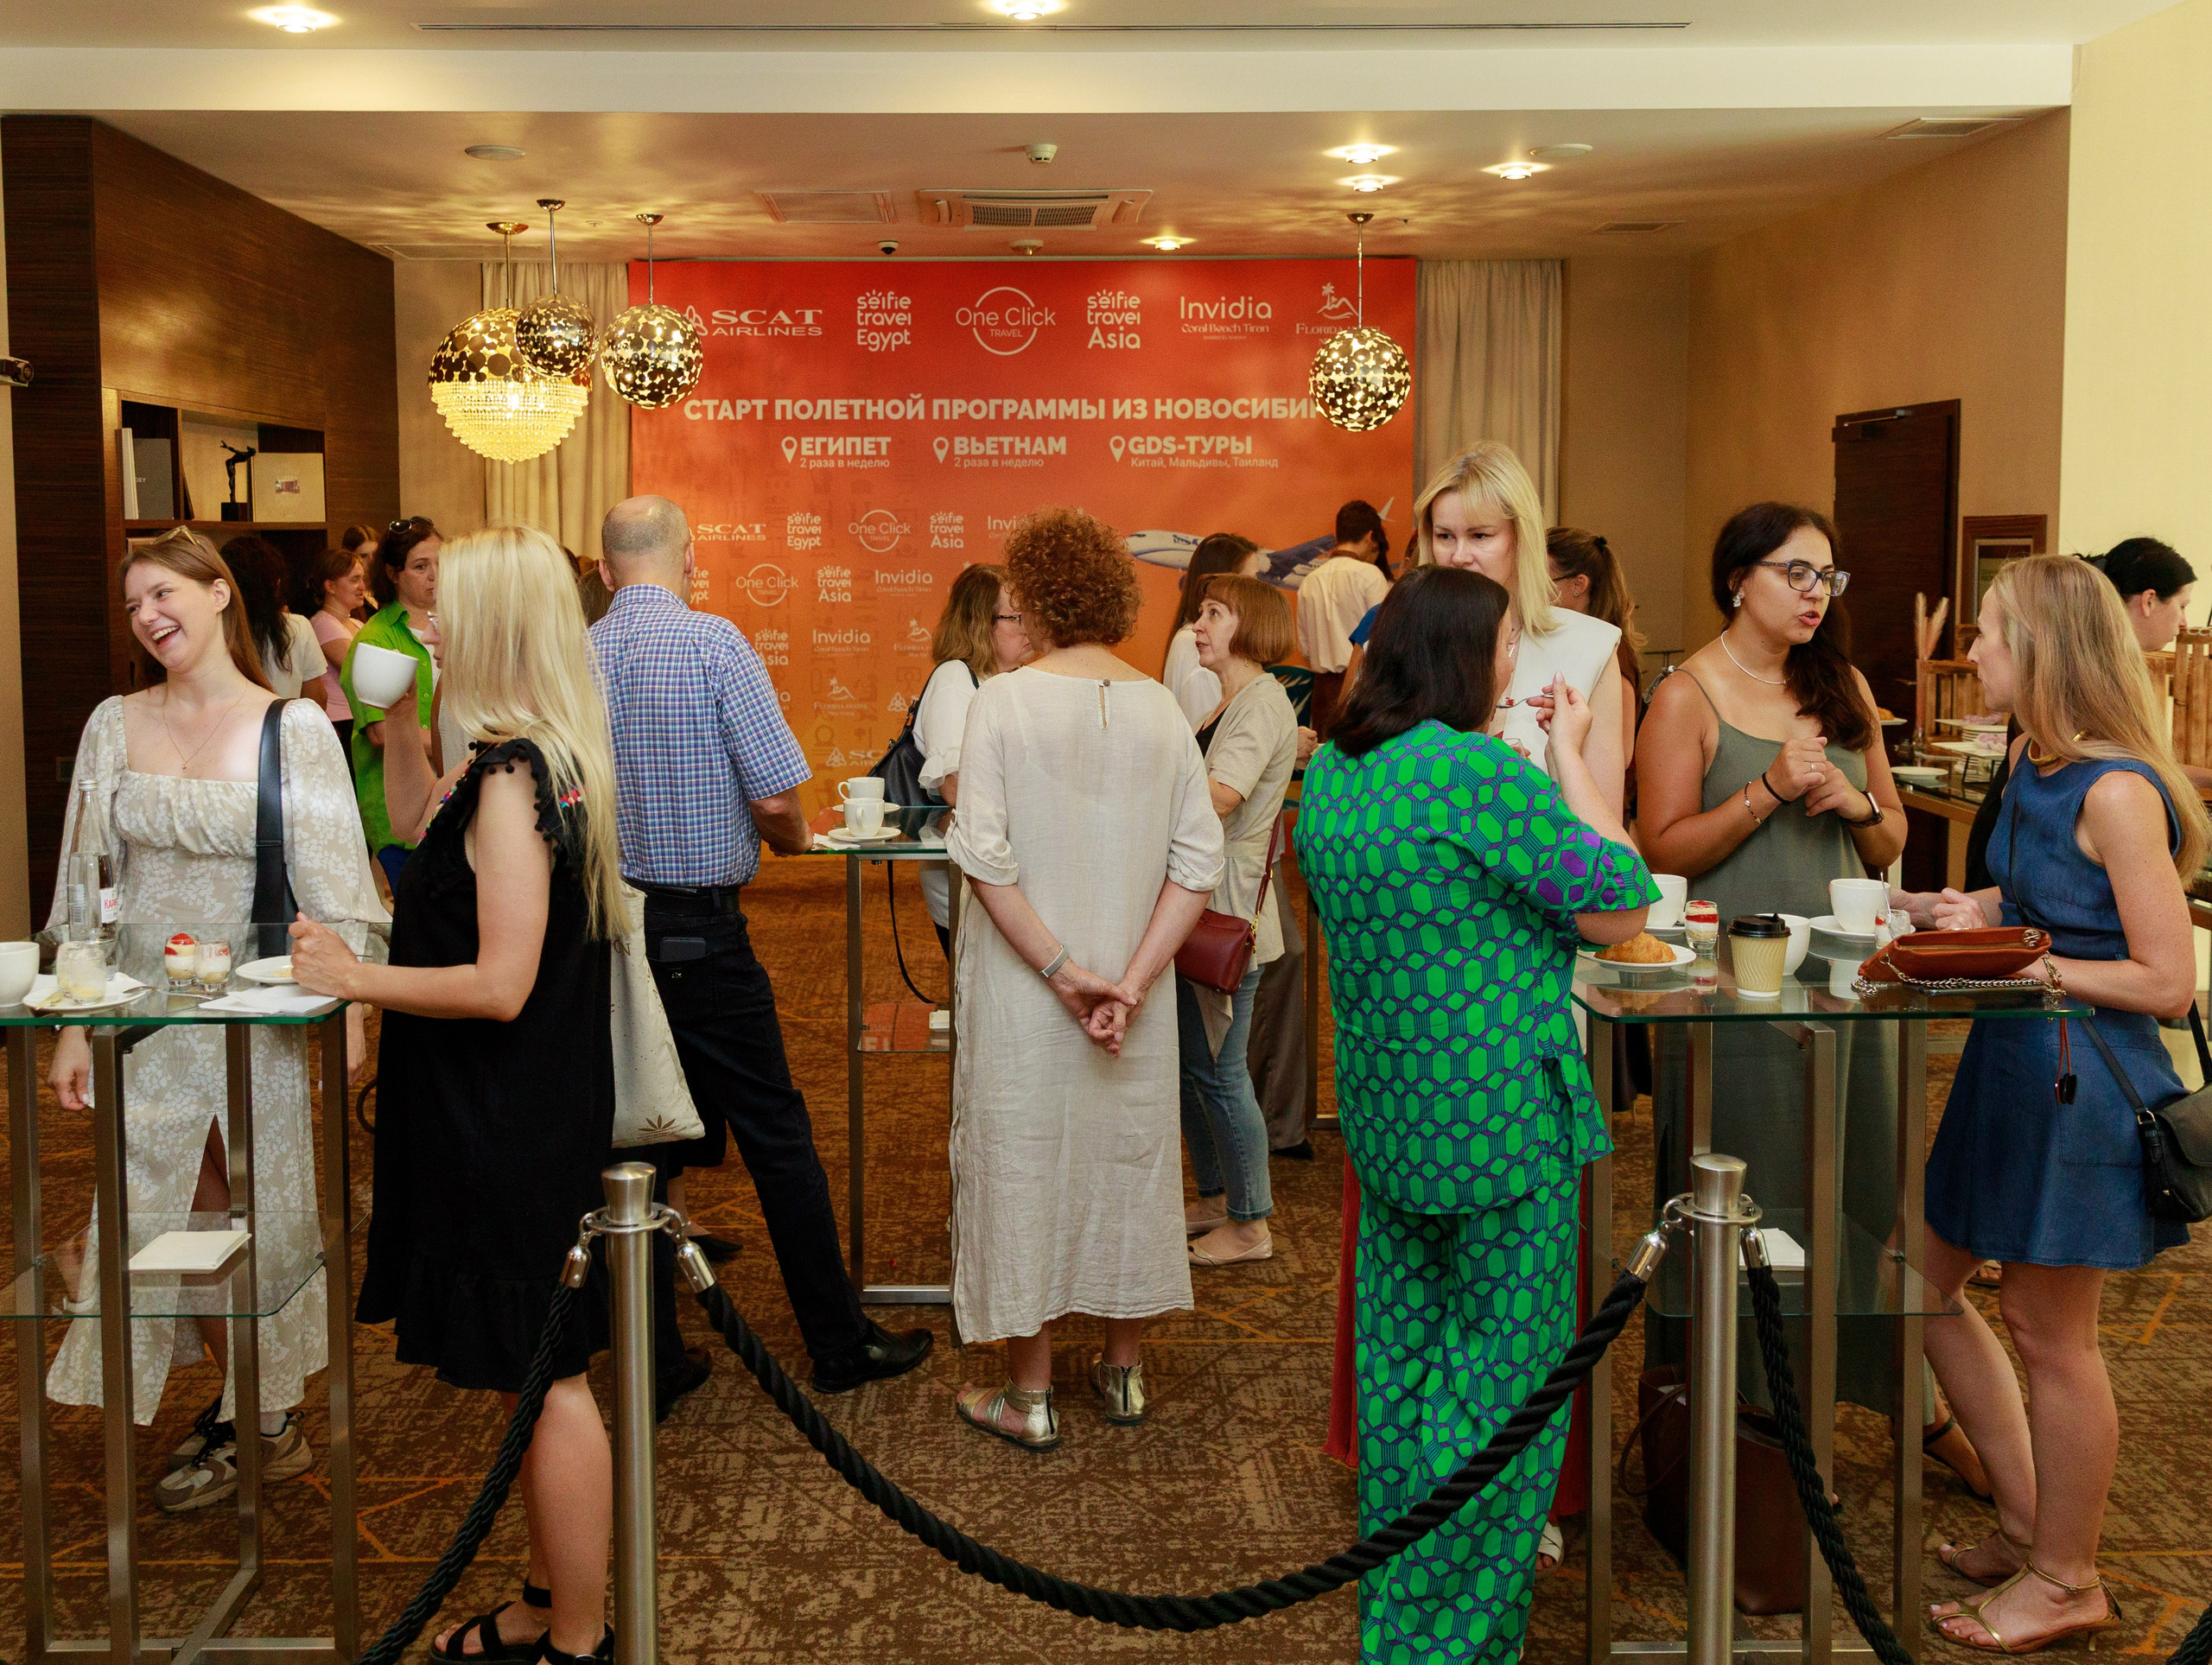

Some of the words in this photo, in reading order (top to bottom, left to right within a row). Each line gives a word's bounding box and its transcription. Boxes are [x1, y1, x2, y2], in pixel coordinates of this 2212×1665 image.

[1180, 296, 1272, 320] Invidia
[711, 309, 823, 325] SCAT
[955, 307, 999, 326] One
[1005, 306, 1056, 326] Click
[712, 327, 823, 337] AIRLINES
[989, 328, 1023, 338] TRAVEL
[1087, 326, 1141, 349] Asia
[856, 328, 912, 353] Egypt
[683, 398, 768, 421] СТАРТ
[775, 394, 925, 421] ПОЛЕТНОЙ
[932, 398, 1105, 420] ПРОГРАММЫ
[1113, 398, 1147, 420] ИЗ
[1154, 398, 1318, 420] НОВОСИБИ
[801, 436, 892, 456] ЕГИПЕТ
[954, 435, 1067, 455] ВЬЕТНАМ
[1128, 435, 1252, 455] GDS-ТУРЫ
[799, 458, 807, 467] 2
[809, 460, 835, 469] раза
[847, 460, 890, 469] неделю
[955, 457, 961, 467] 2
[963, 459, 989, 469] раза
[1001, 459, 1045, 469] неделю
[1131, 457, 1166, 468] Китай,
[1169, 458, 1230, 468] Мальдивы,
[696, 524, 766, 534] SCAT
[848, 522, 875, 535] One
[879, 521, 912, 535] Click
[987, 515, 1017, 531] Invi
[787, 536, 822, 550] Egypt
[931, 534, 964, 549] Asia
[735, 576, 763, 588] One
[766, 575, 798, 588] Click
[874, 569, 933, 585] Invidia
[690, 590, 709, 605] ypt
[818, 588, 852, 602] Asia
[812, 629, 871, 645] Invidia
